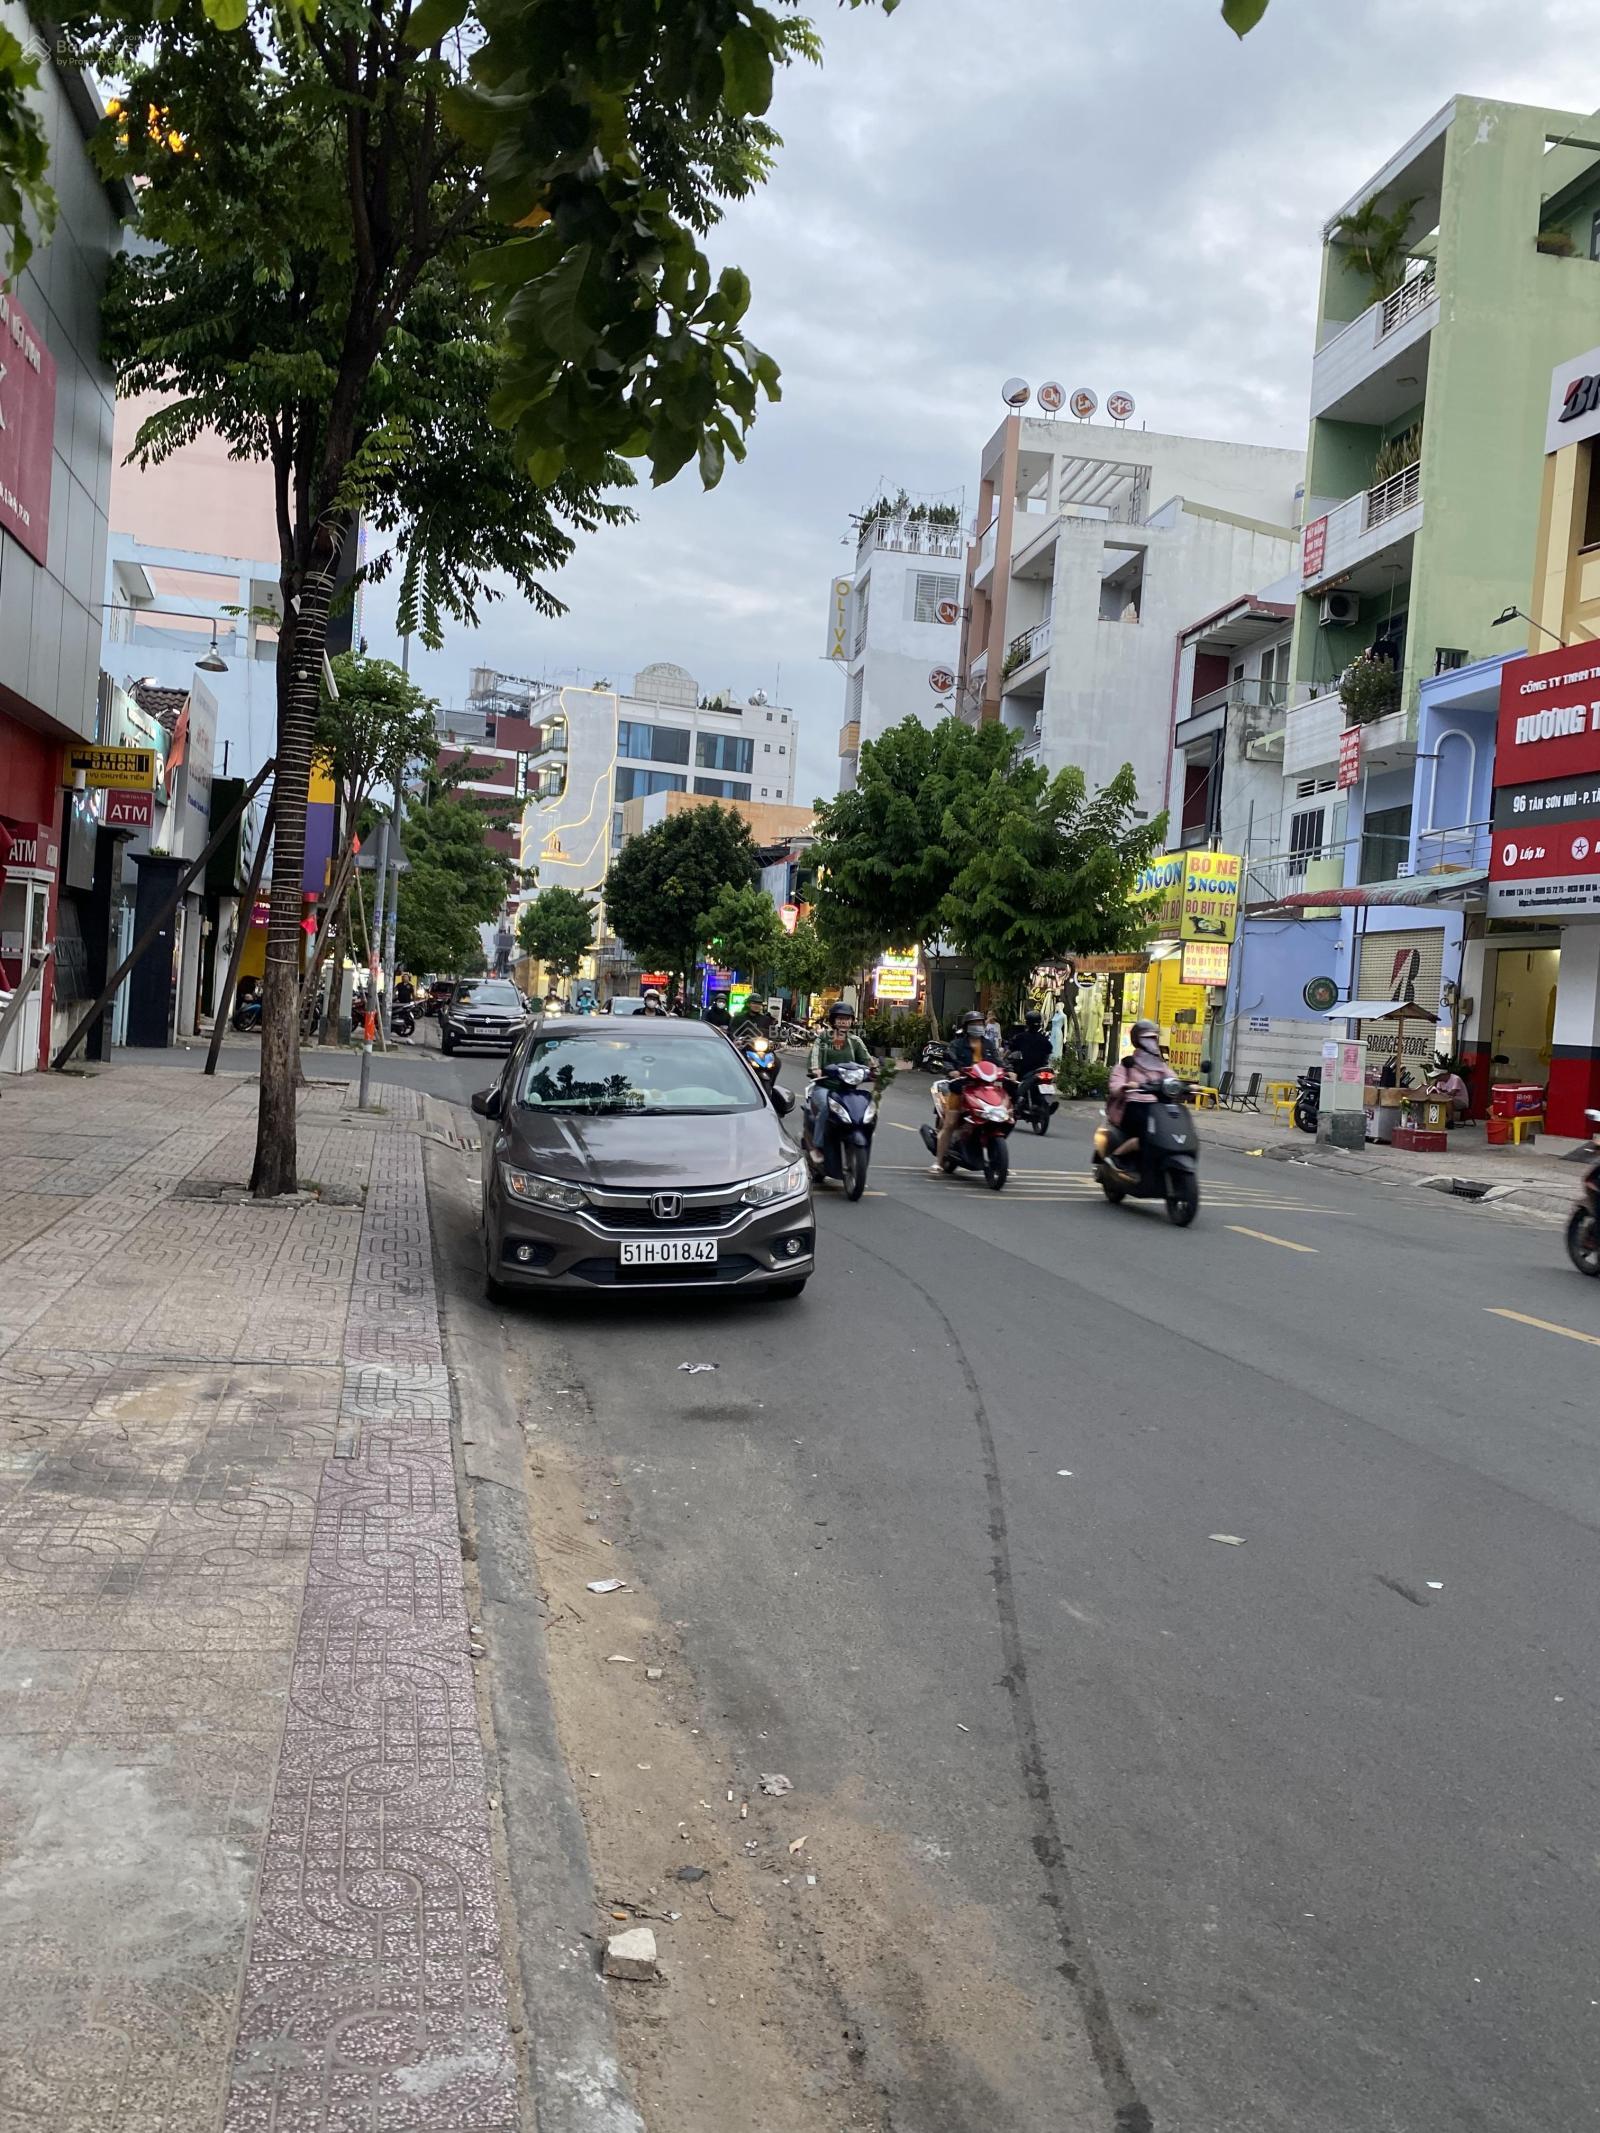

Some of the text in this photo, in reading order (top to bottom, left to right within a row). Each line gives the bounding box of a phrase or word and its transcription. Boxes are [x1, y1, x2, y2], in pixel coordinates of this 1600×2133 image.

[1110, 399, 1132, 414] Spa
[832, 582, 850, 658] OLIVA
[932, 673, 954, 687] Spa
[1519, 680, 1547, 695] CÔNG
[1548, 676, 1563, 688] TY
[72, 752, 136, 762] WESTERN
[91, 761, 136, 771] UNION
[1513, 795, 1526, 812] 96
[110, 804, 148, 822] ATM
[9, 838, 37, 863] ATM
[1535, 846, 1546, 859] Xe
[1216, 858, 1238, 876] NÉ
[624, 1242, 715, 1262] 51H-018.42
